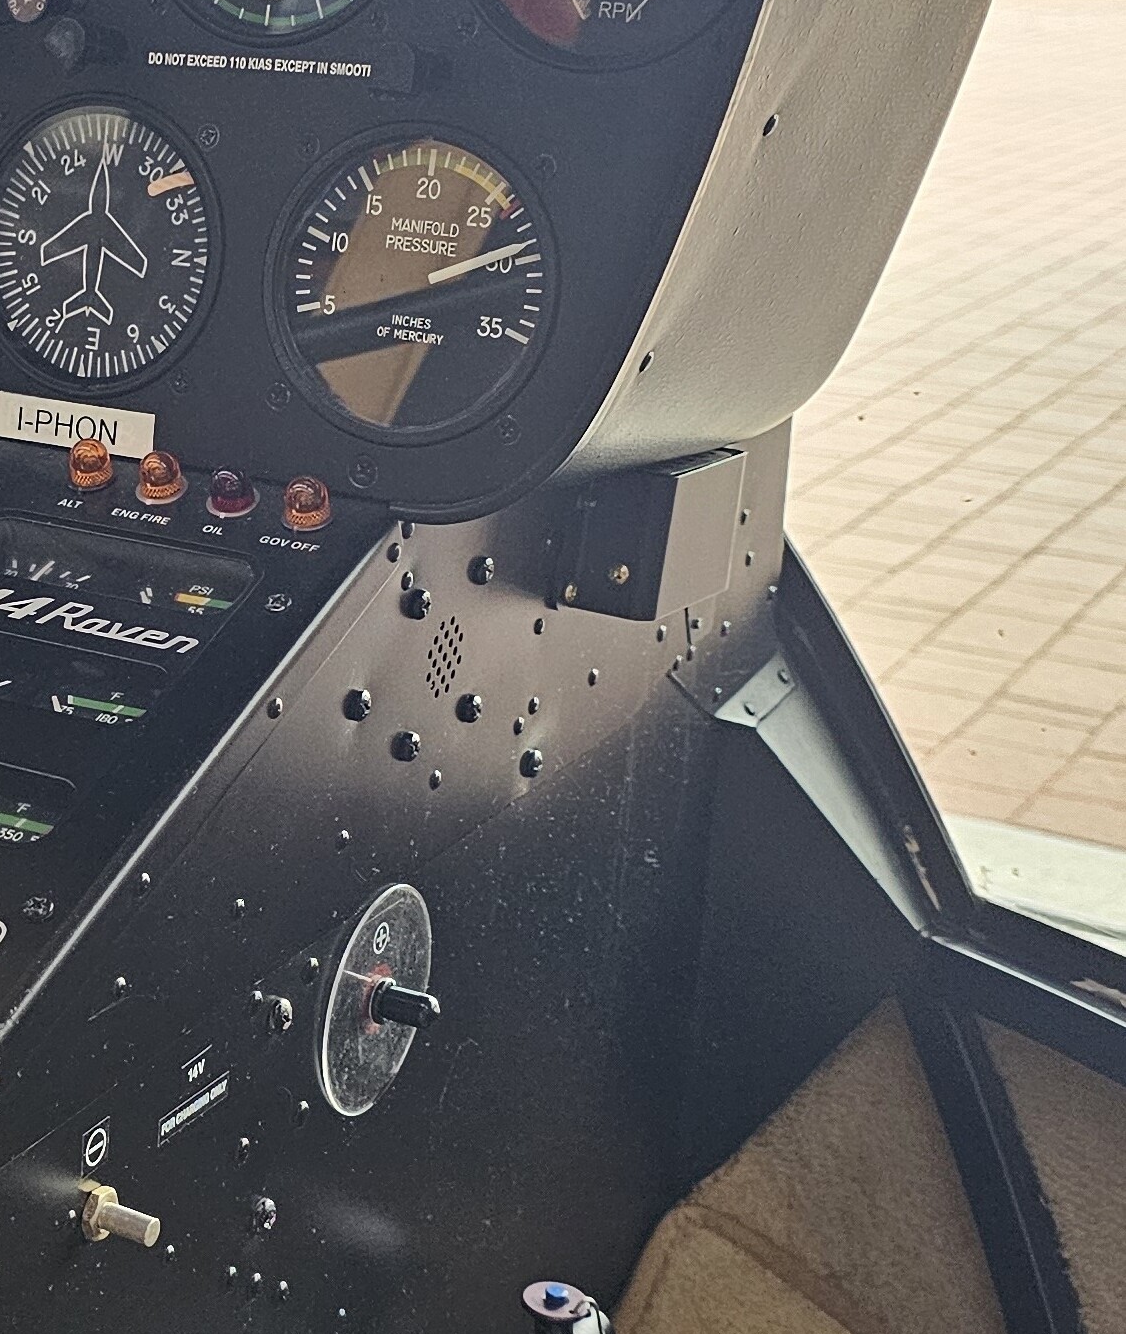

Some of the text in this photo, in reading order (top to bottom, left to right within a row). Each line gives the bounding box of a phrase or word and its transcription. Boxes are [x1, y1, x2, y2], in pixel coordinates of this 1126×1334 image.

[148, 52, 329, 75] DO NOT EXCEED KIAS EXCEPT IN
[415, 177, 441, 199] 20
[365, 195, 383, 216] 15
[390, 217, 460, 238] MANIFOLD
[466, 206, 492, 228] 25
[330, 232, 349, 253] 10
[385, 235, 458, 257] PRESSURE
[391, 314, 432, 330] INCHES
[476, 315, 503, 339] 35
[393, 328, 444, 346] MERCURY
[17, 406, 119, 447] I-PHON
[57, 497, 84, 509] ALT
[110, 507, 172, 526] ENG FIRE
[202, 524, 224, 536] OIL
[259, 535, 321, 554] GOV OFF
[34, 600, 200, 654] Raven
